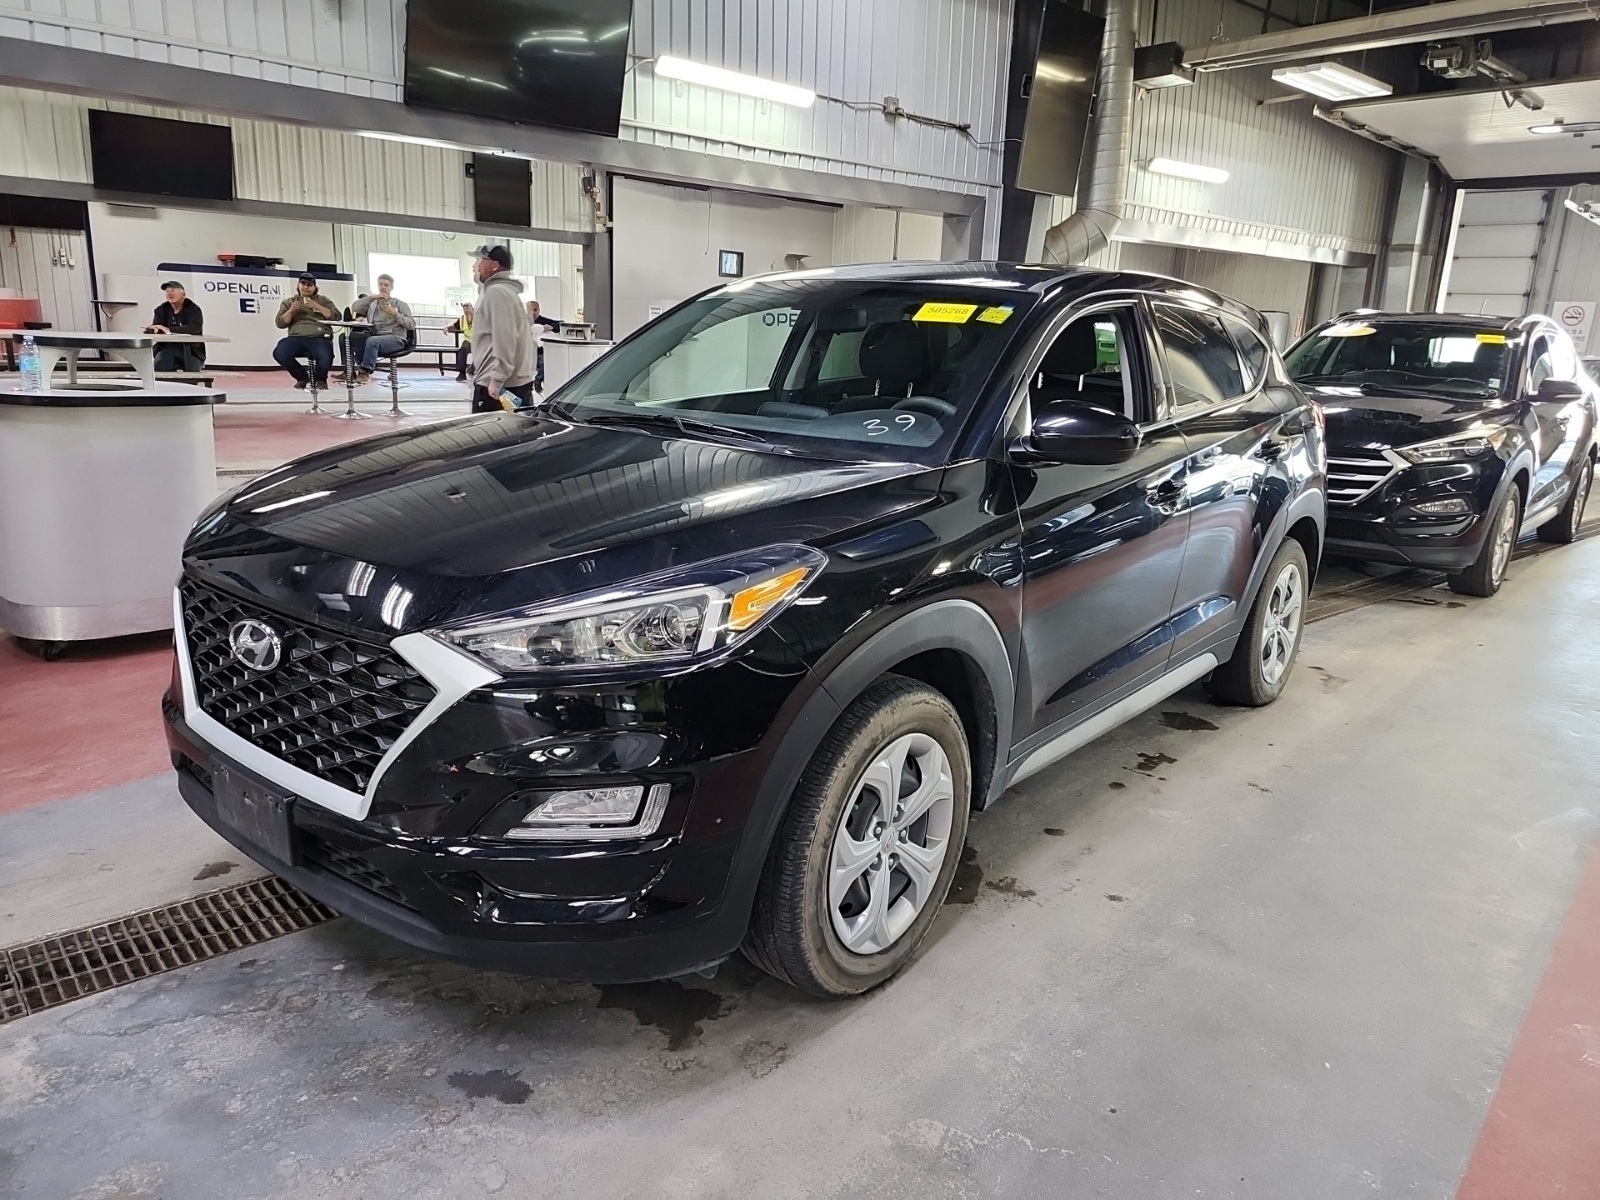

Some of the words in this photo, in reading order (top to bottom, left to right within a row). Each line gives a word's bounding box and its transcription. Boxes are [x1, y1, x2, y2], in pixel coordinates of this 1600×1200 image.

[240, 298, 256, 313] E
[927, 306, 969, 315] 505268
[862, 414, 916, 436] 39
